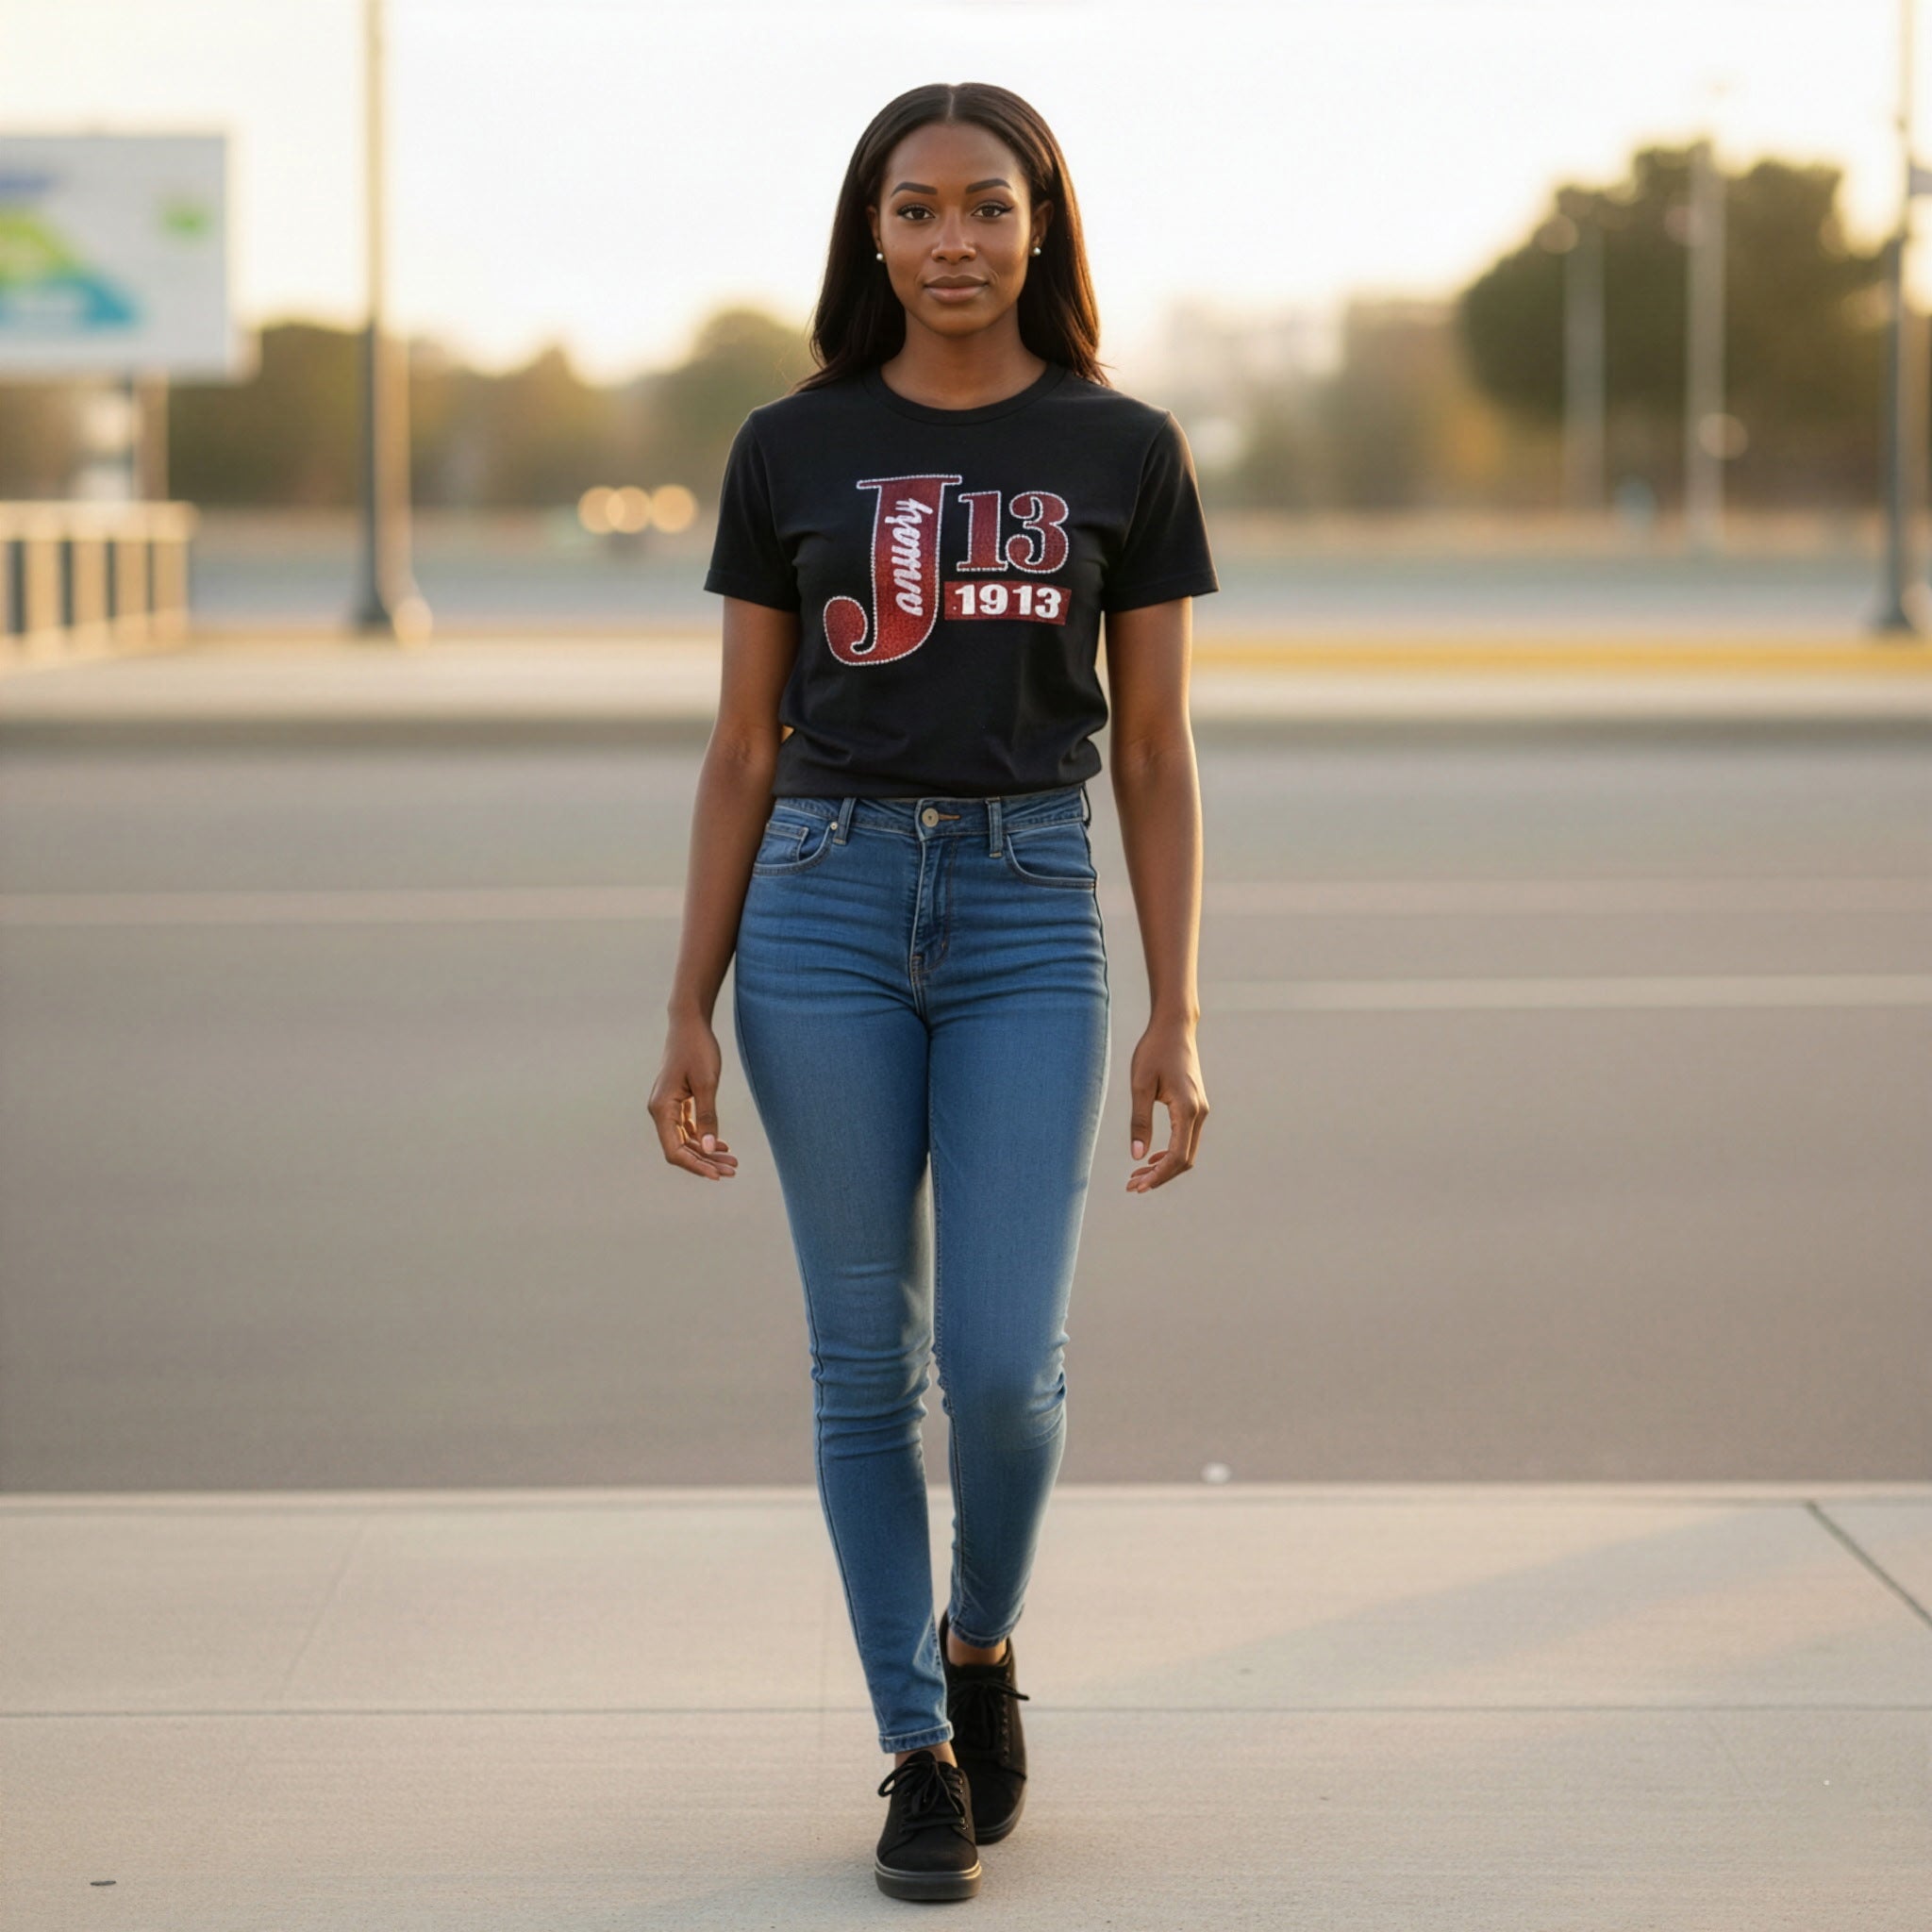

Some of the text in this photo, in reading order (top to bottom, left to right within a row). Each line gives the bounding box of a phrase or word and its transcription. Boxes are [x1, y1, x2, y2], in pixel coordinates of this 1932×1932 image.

[823, 474, 962, 666] J
[957, 490, 1070, 574] 13
[955, 584, 1062, 619] 1913
